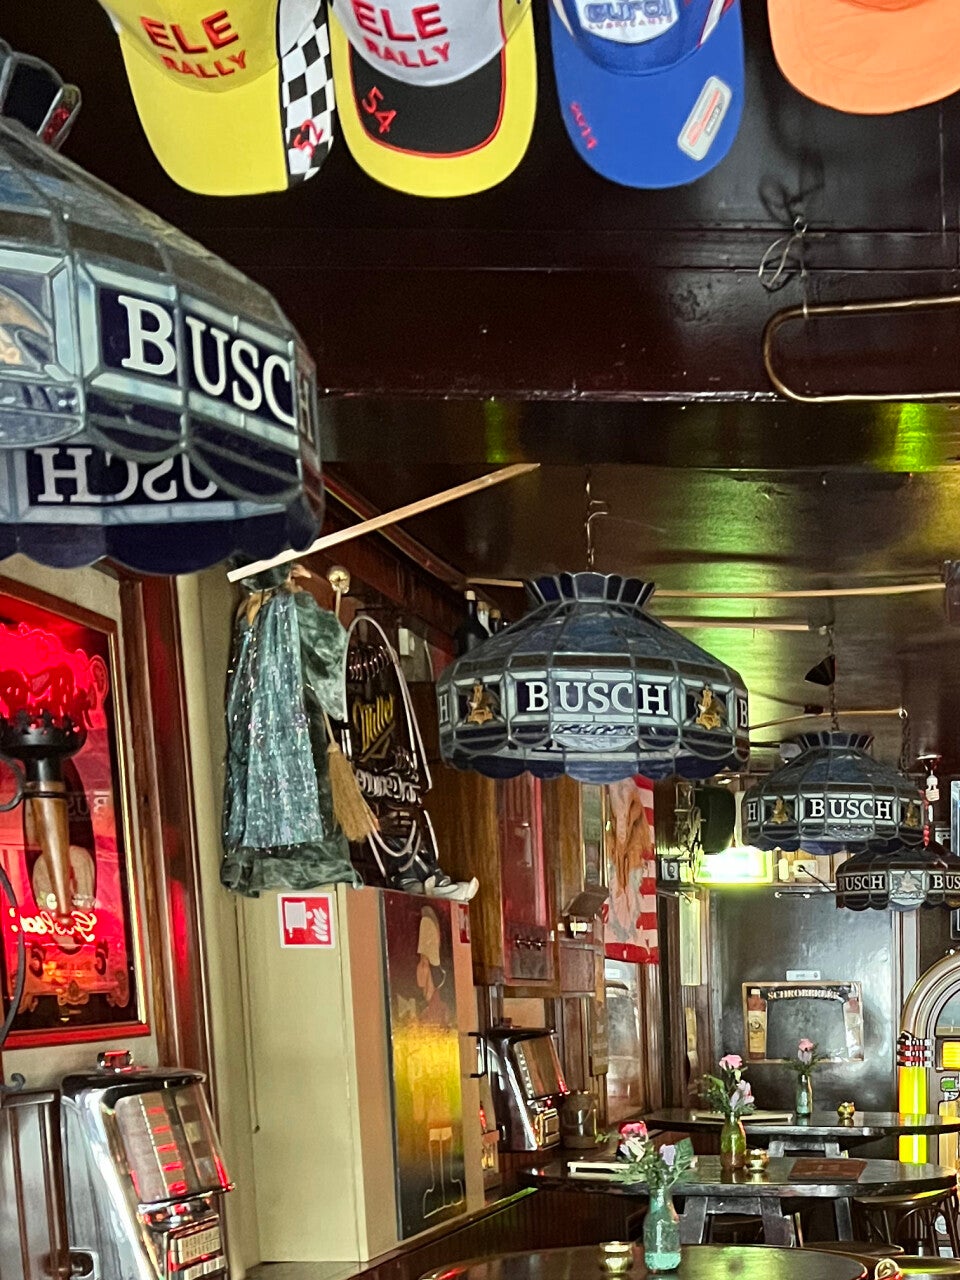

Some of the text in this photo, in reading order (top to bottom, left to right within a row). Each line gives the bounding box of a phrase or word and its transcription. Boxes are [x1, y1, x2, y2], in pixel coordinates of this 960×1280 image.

[140, 10, 239, 54] ELE
[352, 0, 448, 42] ELE
[160, 50, 246, 78] RALLY
[363, 41, 450, 68] RALLY
[362, 86, 397, 134] 54
[293, 119, 324, 159] 52
[525, 681, 669, 716] BUSCH
[809, 797, 893, 820] BUSCH
